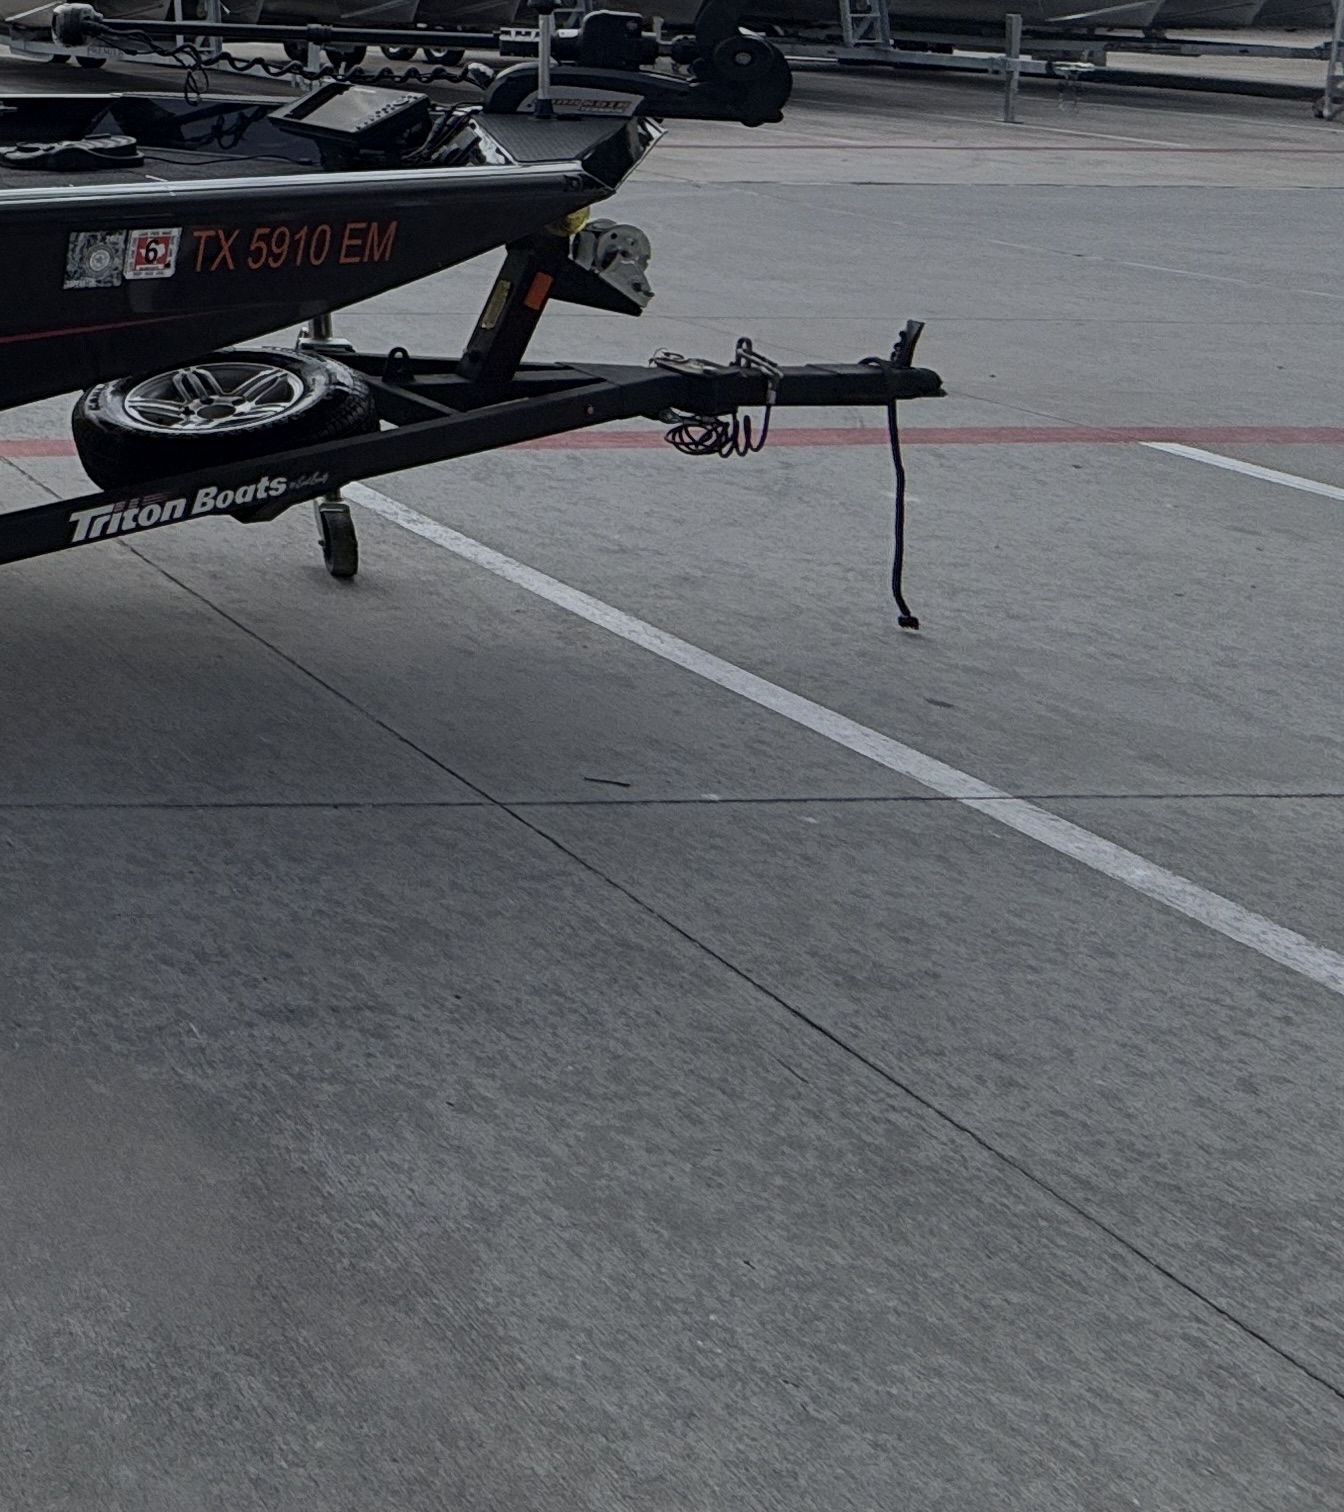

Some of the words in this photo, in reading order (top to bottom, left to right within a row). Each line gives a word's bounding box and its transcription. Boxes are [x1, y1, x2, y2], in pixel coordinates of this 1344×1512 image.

[144, 239, 159, 264] 6
[192, 228, 241, 273] TX
[247, 223, 331, 270] 5910
[338, 220, 408, 265] EM
[69, 495, 187, 543] Triton
[191, 475, 287, 515] Boats
